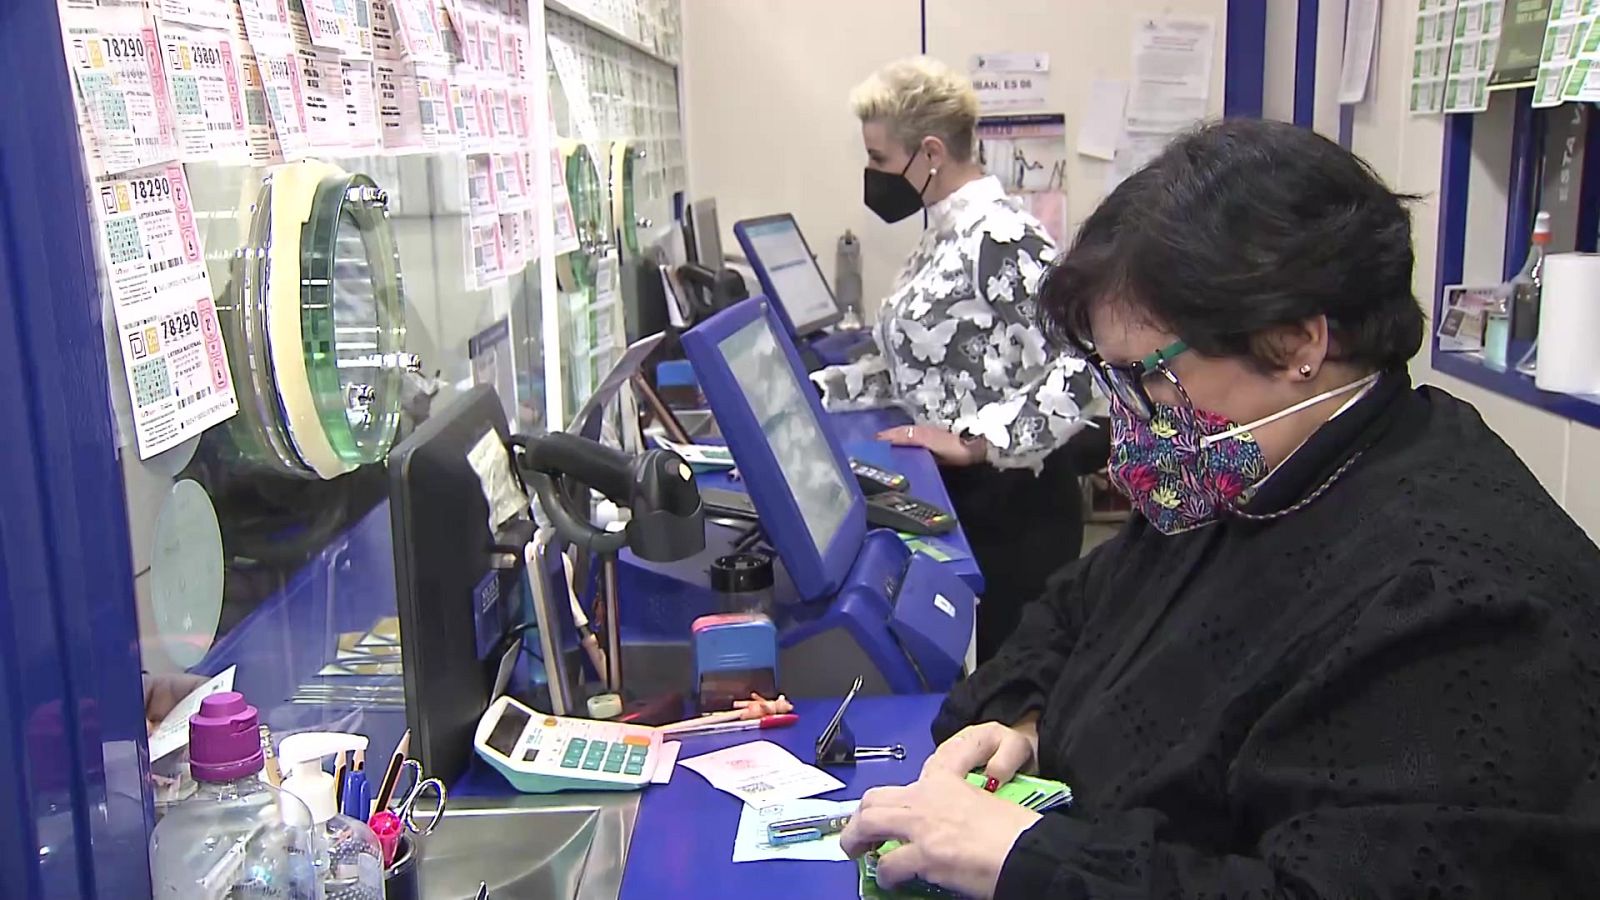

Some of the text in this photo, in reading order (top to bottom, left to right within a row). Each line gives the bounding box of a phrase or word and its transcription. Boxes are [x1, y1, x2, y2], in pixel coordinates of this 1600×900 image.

[102, 38, 144, 57] 78290
[130, 177, 170, 200] 78290
[160, 310, 199, 339] 78290
